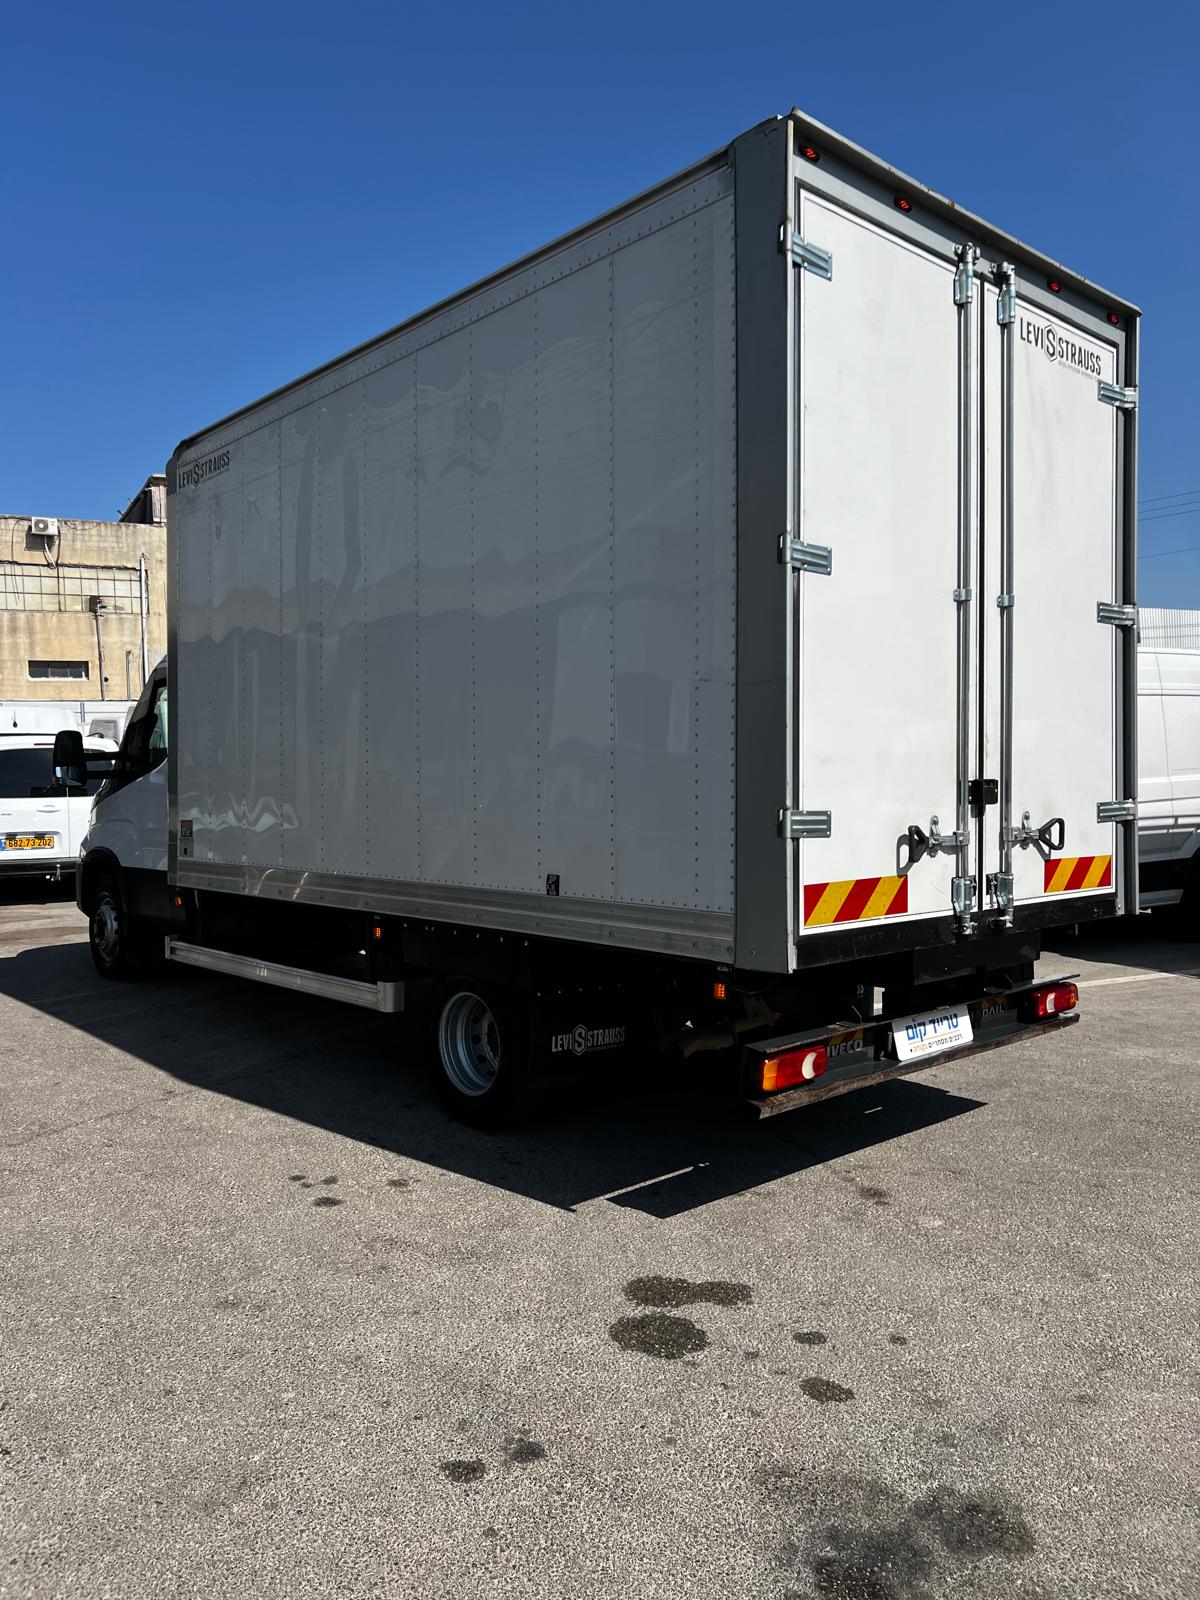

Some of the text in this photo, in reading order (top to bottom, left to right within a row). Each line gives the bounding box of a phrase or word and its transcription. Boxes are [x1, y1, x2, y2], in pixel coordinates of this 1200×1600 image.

[905, 1013, 959, 1042] טרייד קום
[826, 1039, 864, 1058] IVECO
